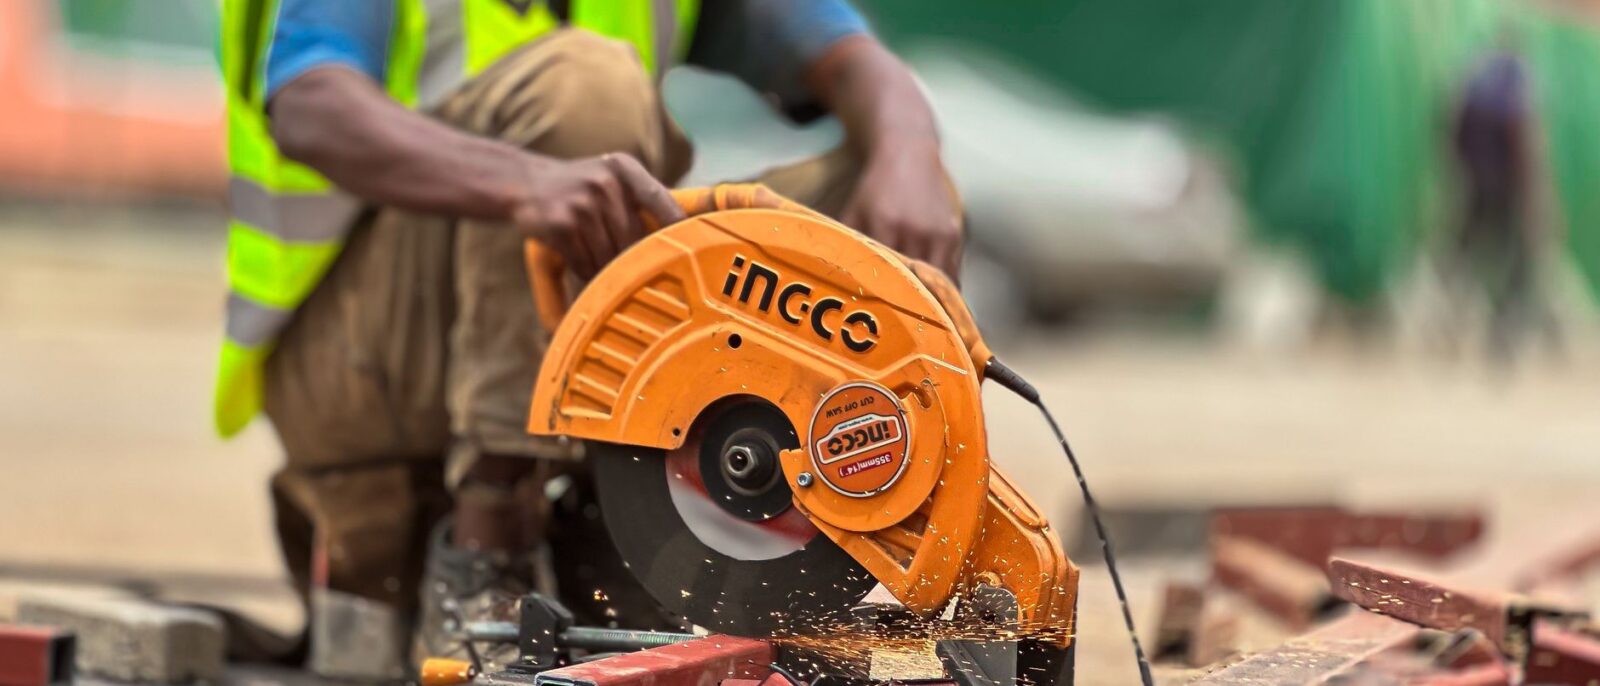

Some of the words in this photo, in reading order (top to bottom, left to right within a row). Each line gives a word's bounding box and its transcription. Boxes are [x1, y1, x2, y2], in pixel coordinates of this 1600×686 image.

[844, 401, 858, 412] OFF
[860, 396, 875, 407] CUT
[826, 406, 842, 418] SAW
